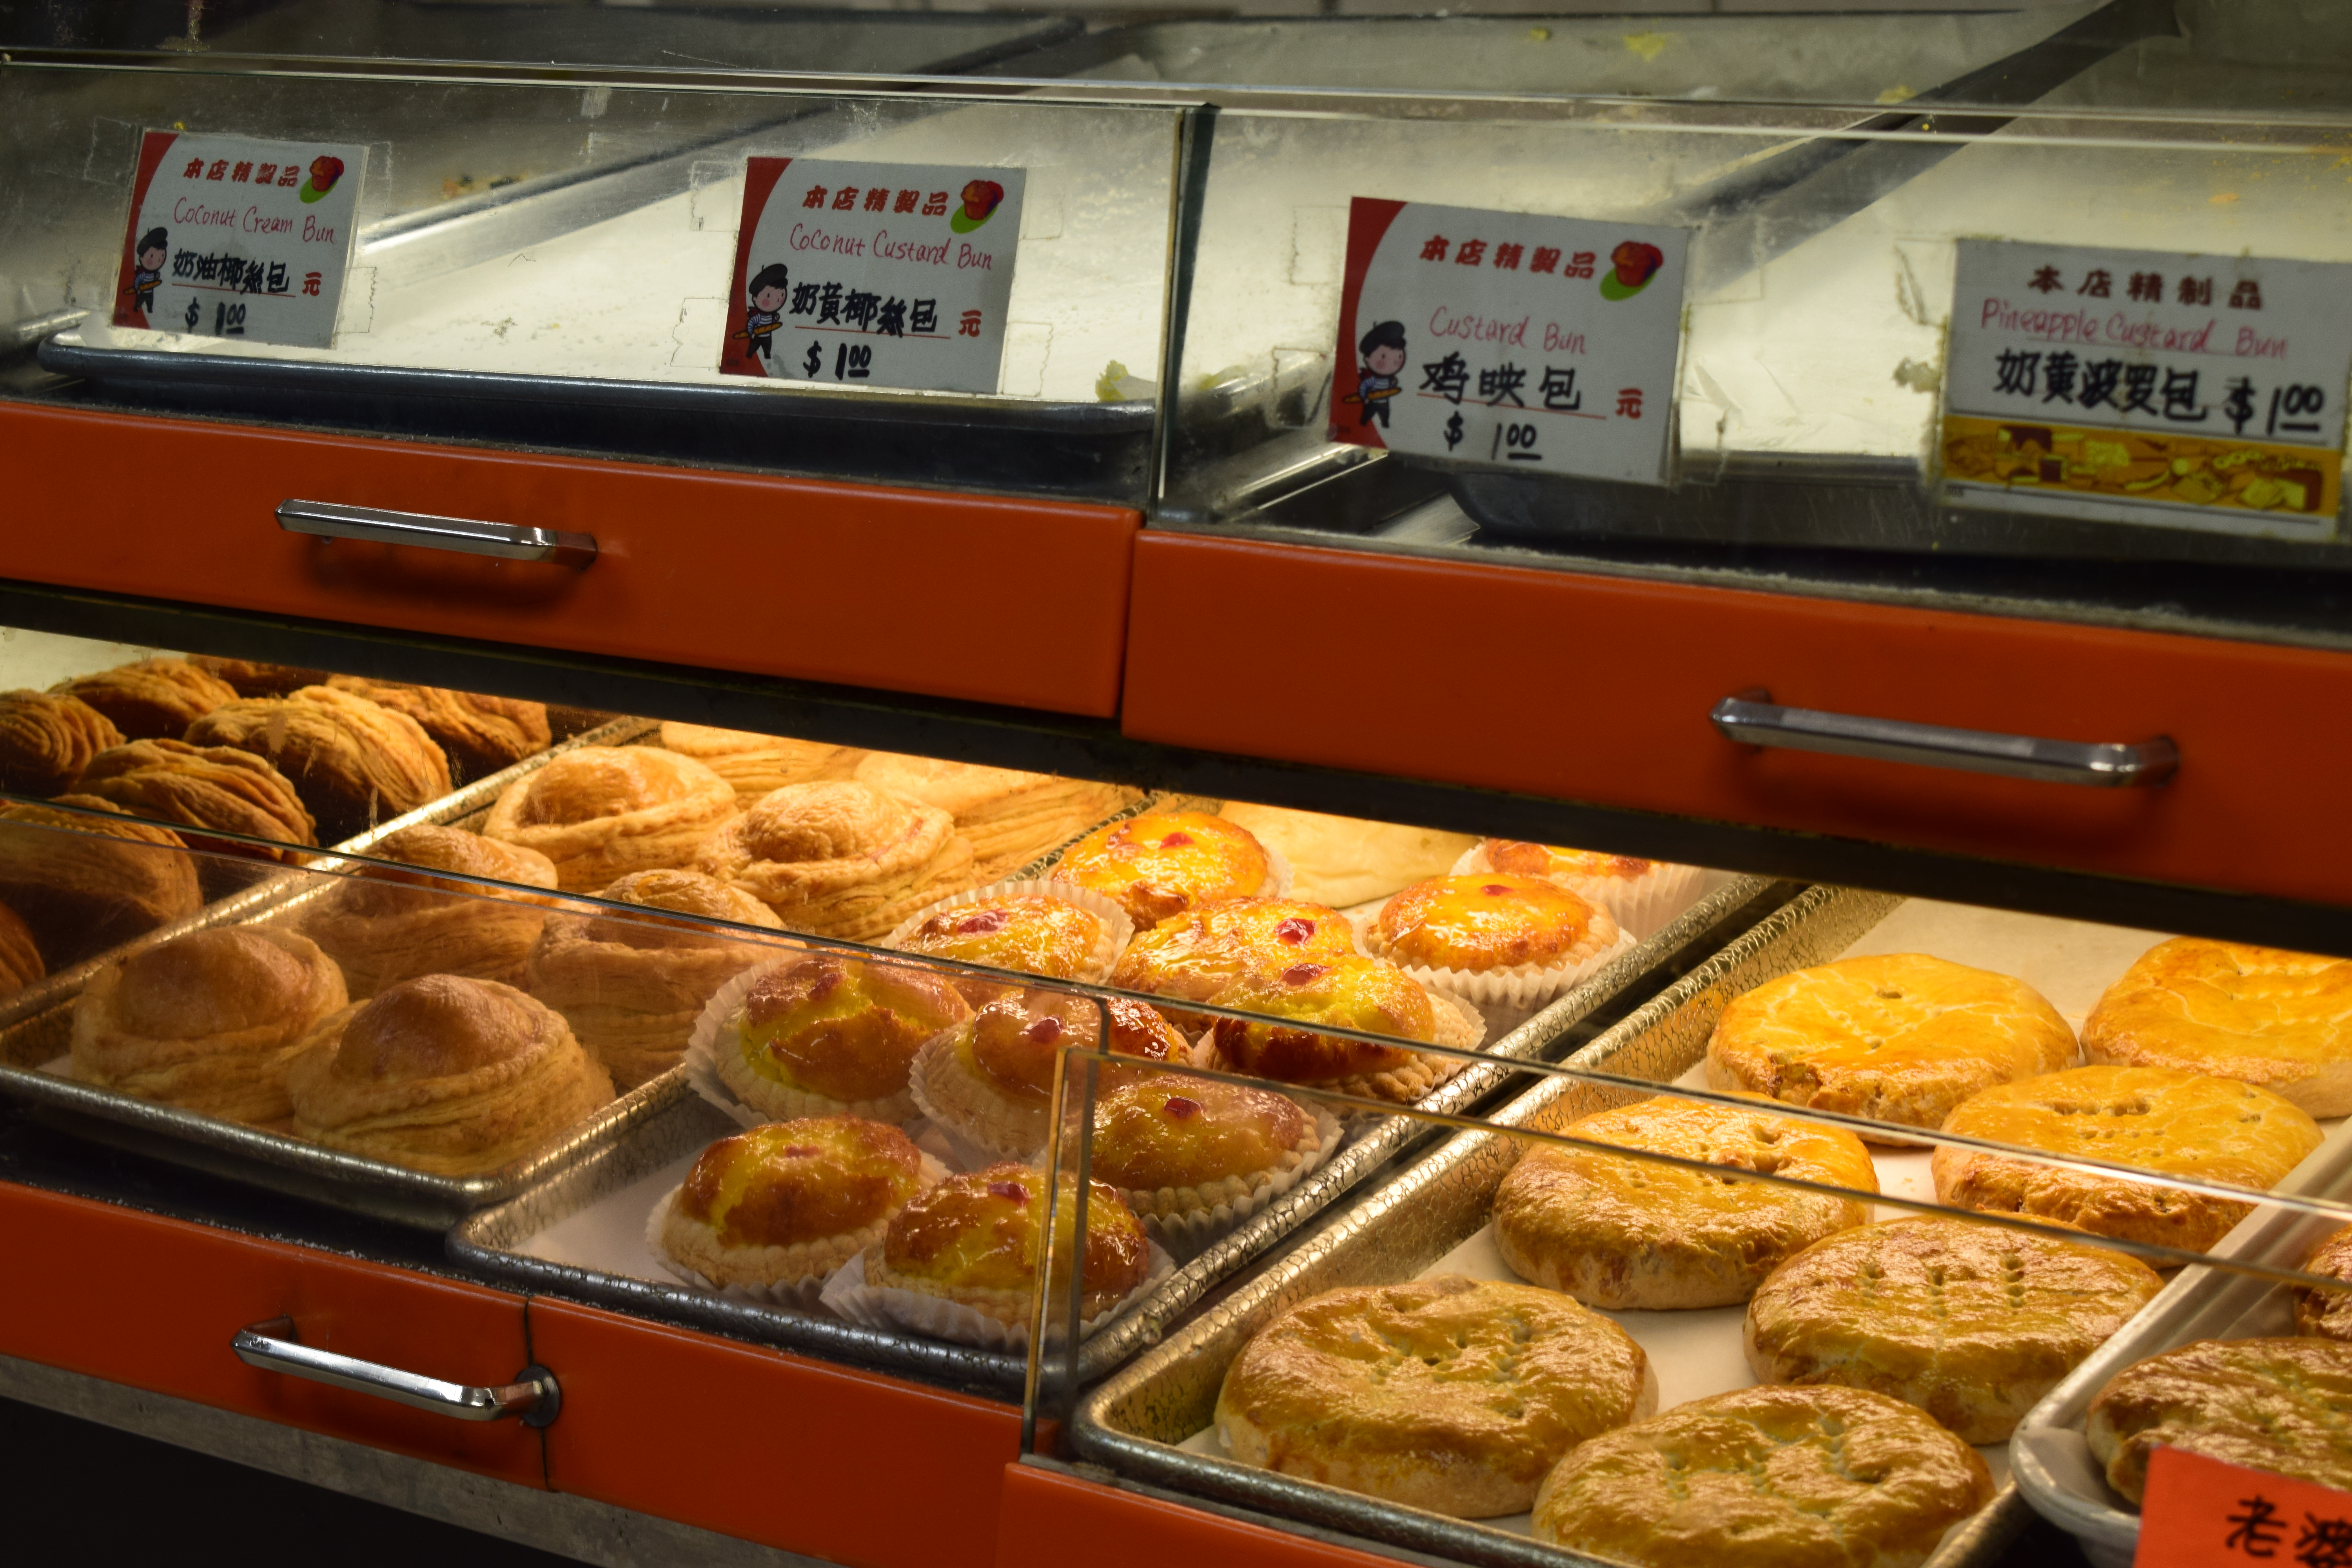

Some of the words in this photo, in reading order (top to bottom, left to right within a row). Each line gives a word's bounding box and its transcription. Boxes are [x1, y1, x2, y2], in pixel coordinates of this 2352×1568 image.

[183, 158, 299, 187] 本店精製品
[174, 197, 236, 227] Coconut
[242, 205, 293, 234] Cream
[301, 214, 335, 243] Bun
[802, 185, 949, 217] 本店精製品
[789, 222, 866, 257] Coconut
[873, 229, 951, 265] Custard
[957, 243, 992, 270] Bun
[1419, 235, 1596, 279] 本店精製品
[302, 271, 322, 296] 元
[2028, 265, 2262, 310] 本店精制品
[958, 309, 982, 338] 元
[1429, 306, 1529, 347] Custard
[1543, 322, 1585, 355] Bun
[1980, 299, 2098, 342] Pineapple
[2105, 310, 2215, 352] Custard
[2235, 326, 2288, 359] Bun
[1615, 388, 1642, 420] 元
